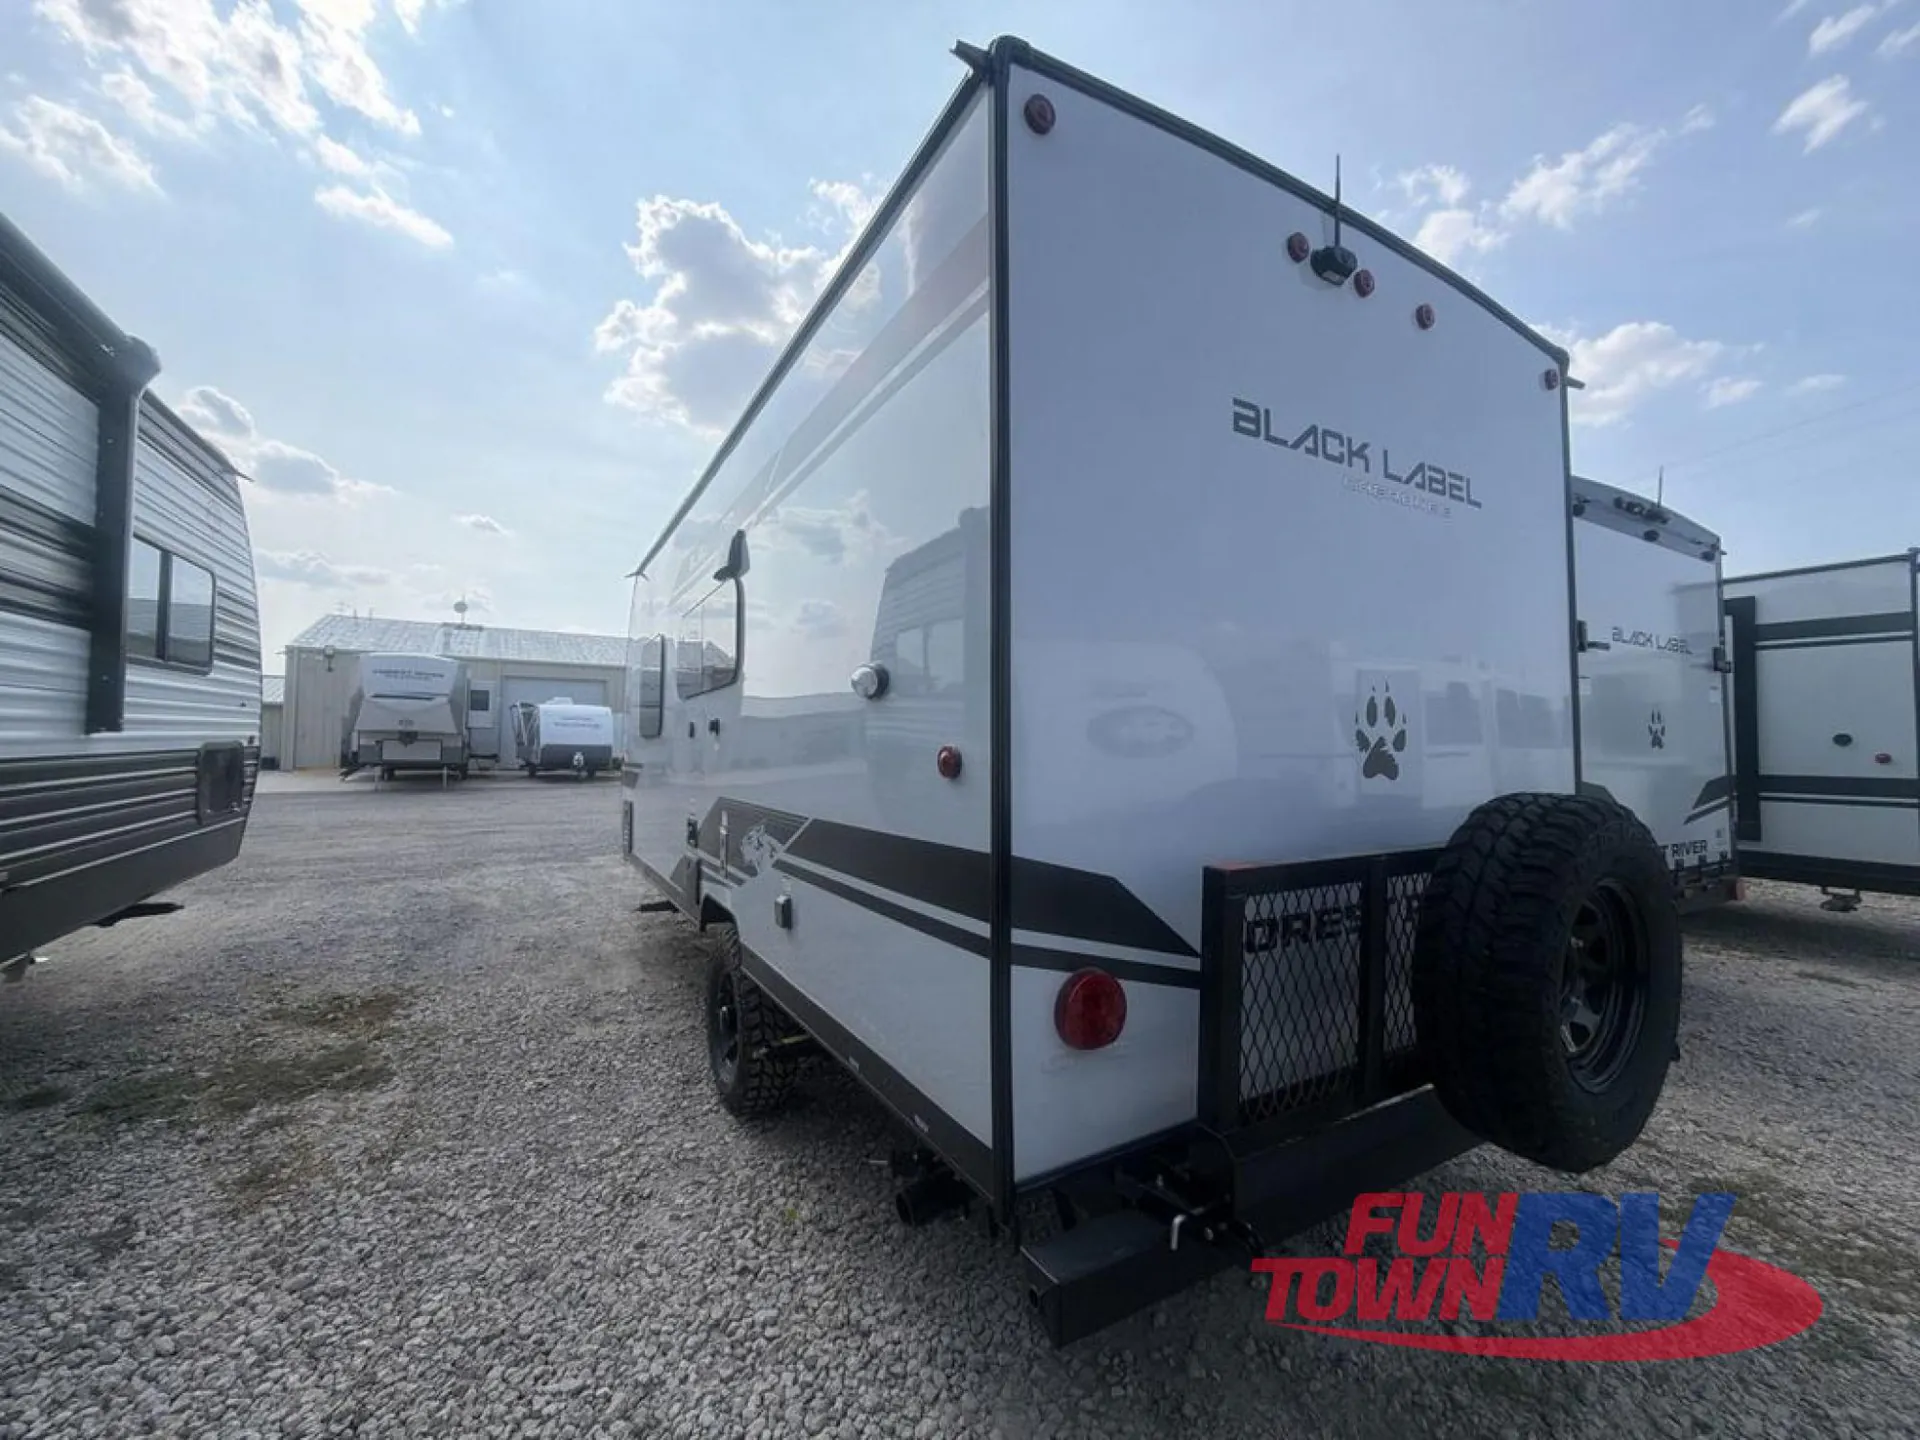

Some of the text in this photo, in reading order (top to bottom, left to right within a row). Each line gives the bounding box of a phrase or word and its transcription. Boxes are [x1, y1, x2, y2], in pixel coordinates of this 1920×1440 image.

[1232, 397, 1371, 474] BLACK
[1383, 449, 1483, 509] LABEL
[1612, 626, 1694, 655] BLACK LABEL
[1671, 839, 1708, 858] RIVER
